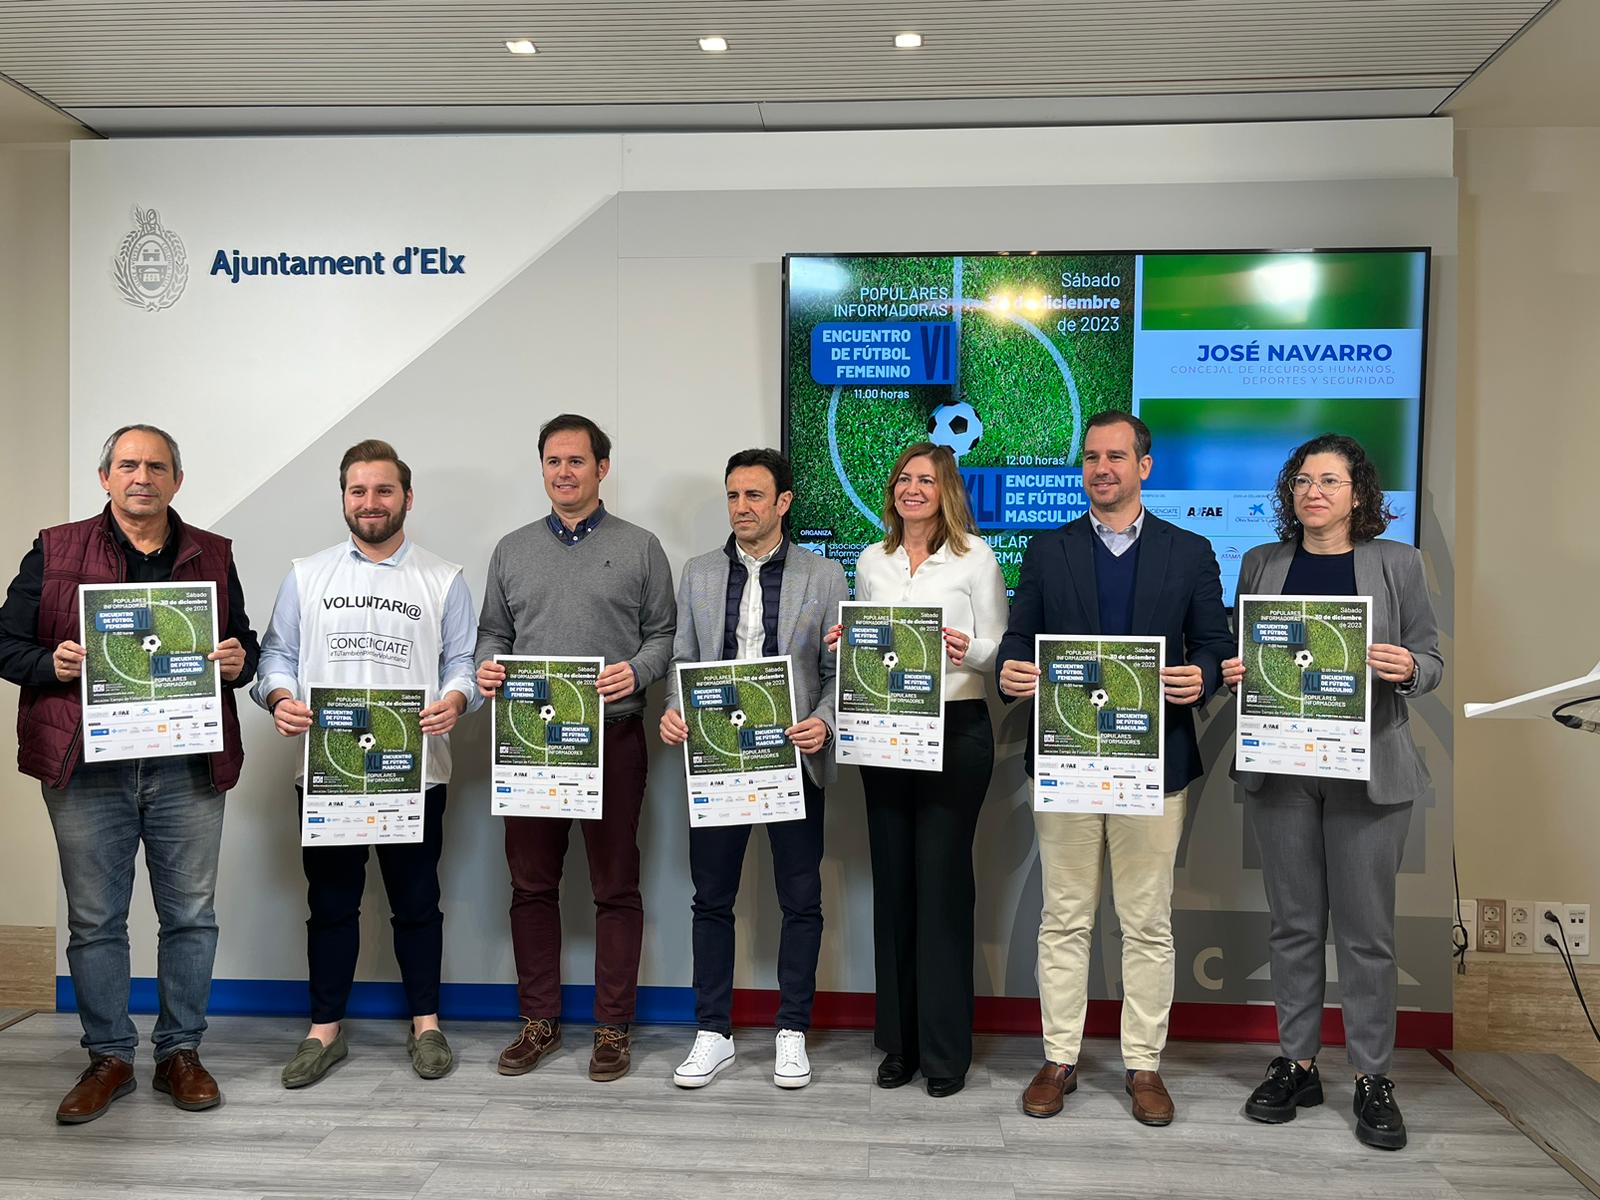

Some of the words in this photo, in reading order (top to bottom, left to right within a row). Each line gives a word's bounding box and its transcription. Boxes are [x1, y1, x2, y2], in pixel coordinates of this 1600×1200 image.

[210, 247, 385, 284] Ajuntament
[1061, 272, 1120, 288] Sábado
[860, 287, 948, 300] POPULARES
[834, 304, 948, 317] INFORMADORAS
[1057, 318, 1076, 332] de
[1080, 316, 1120, 332] 2023
[822, 330, 911, 343] ENCUENTRO
[832, 348, 850, 361] DE
[854, 345, 911, 361] FÚTBOL
[920, 326, 950, 380] VI
[1196, 340, 1260, 362] JOSÉ
[1268, 344, 1392, 362] NAVARRO
[836, 365, 911, 378] FEMENINO
[1170, 365, 1232, 374] CONCEJAL
[1239, 366, 1256, 374] DE
[1260, 366, 1324, 374] RECURSOS
[1243, 376, 1307, 384] DEPORTES
[1311, 376, 1318, 384] Y
[1322, 376, 1395, 384] SEGURIDAD
[880, 388, 910, 398] horas
[1035, 456, 1064, 466] horas
[1005, 474, 1083, 488] ENCUENTR
[1005, 492, 1026, 505] DE
[1028, 490, 1087, 505] FÚTBOL
[1005, 510, 1088, 522] MASCULIN
[323, 596, 422, 620] VOLUNTARI@
